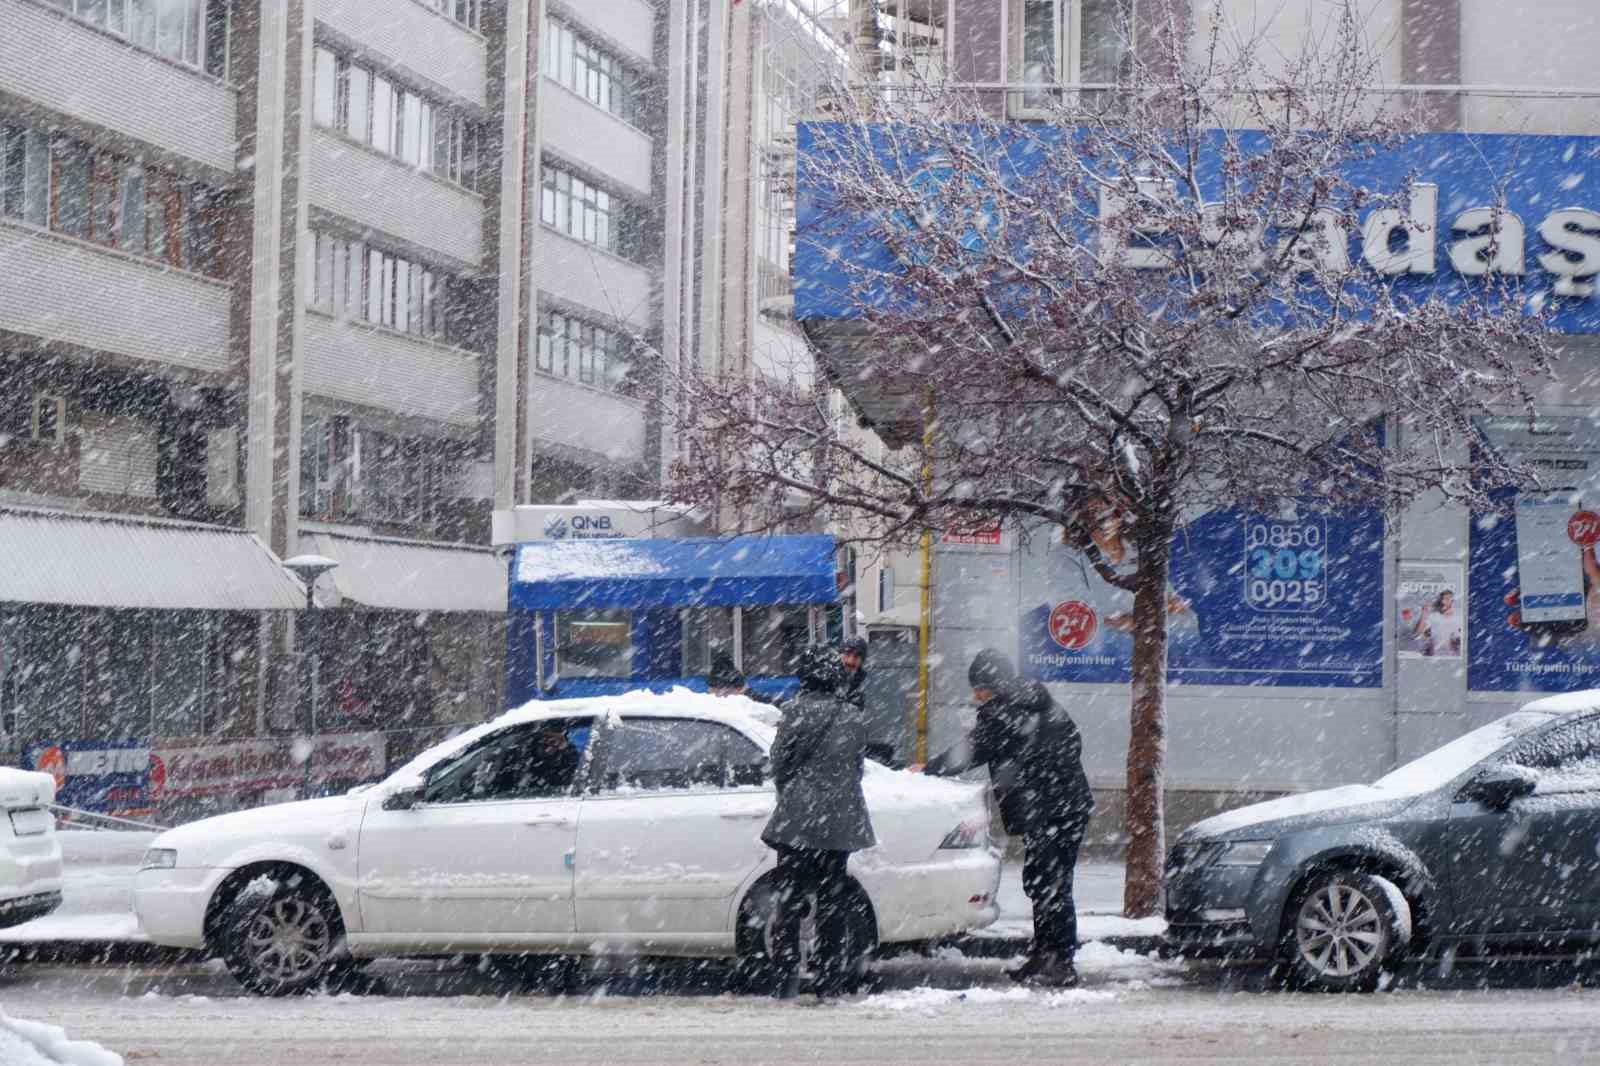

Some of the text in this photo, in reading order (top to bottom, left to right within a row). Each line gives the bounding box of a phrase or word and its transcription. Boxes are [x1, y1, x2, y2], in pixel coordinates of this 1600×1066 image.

[571, 515, 612, 530] QNB
[1251, 525, 1320, 547] 0850
[1251, 549, 1321, 578] 309
[1251, 580, 1320, 602] 0025
